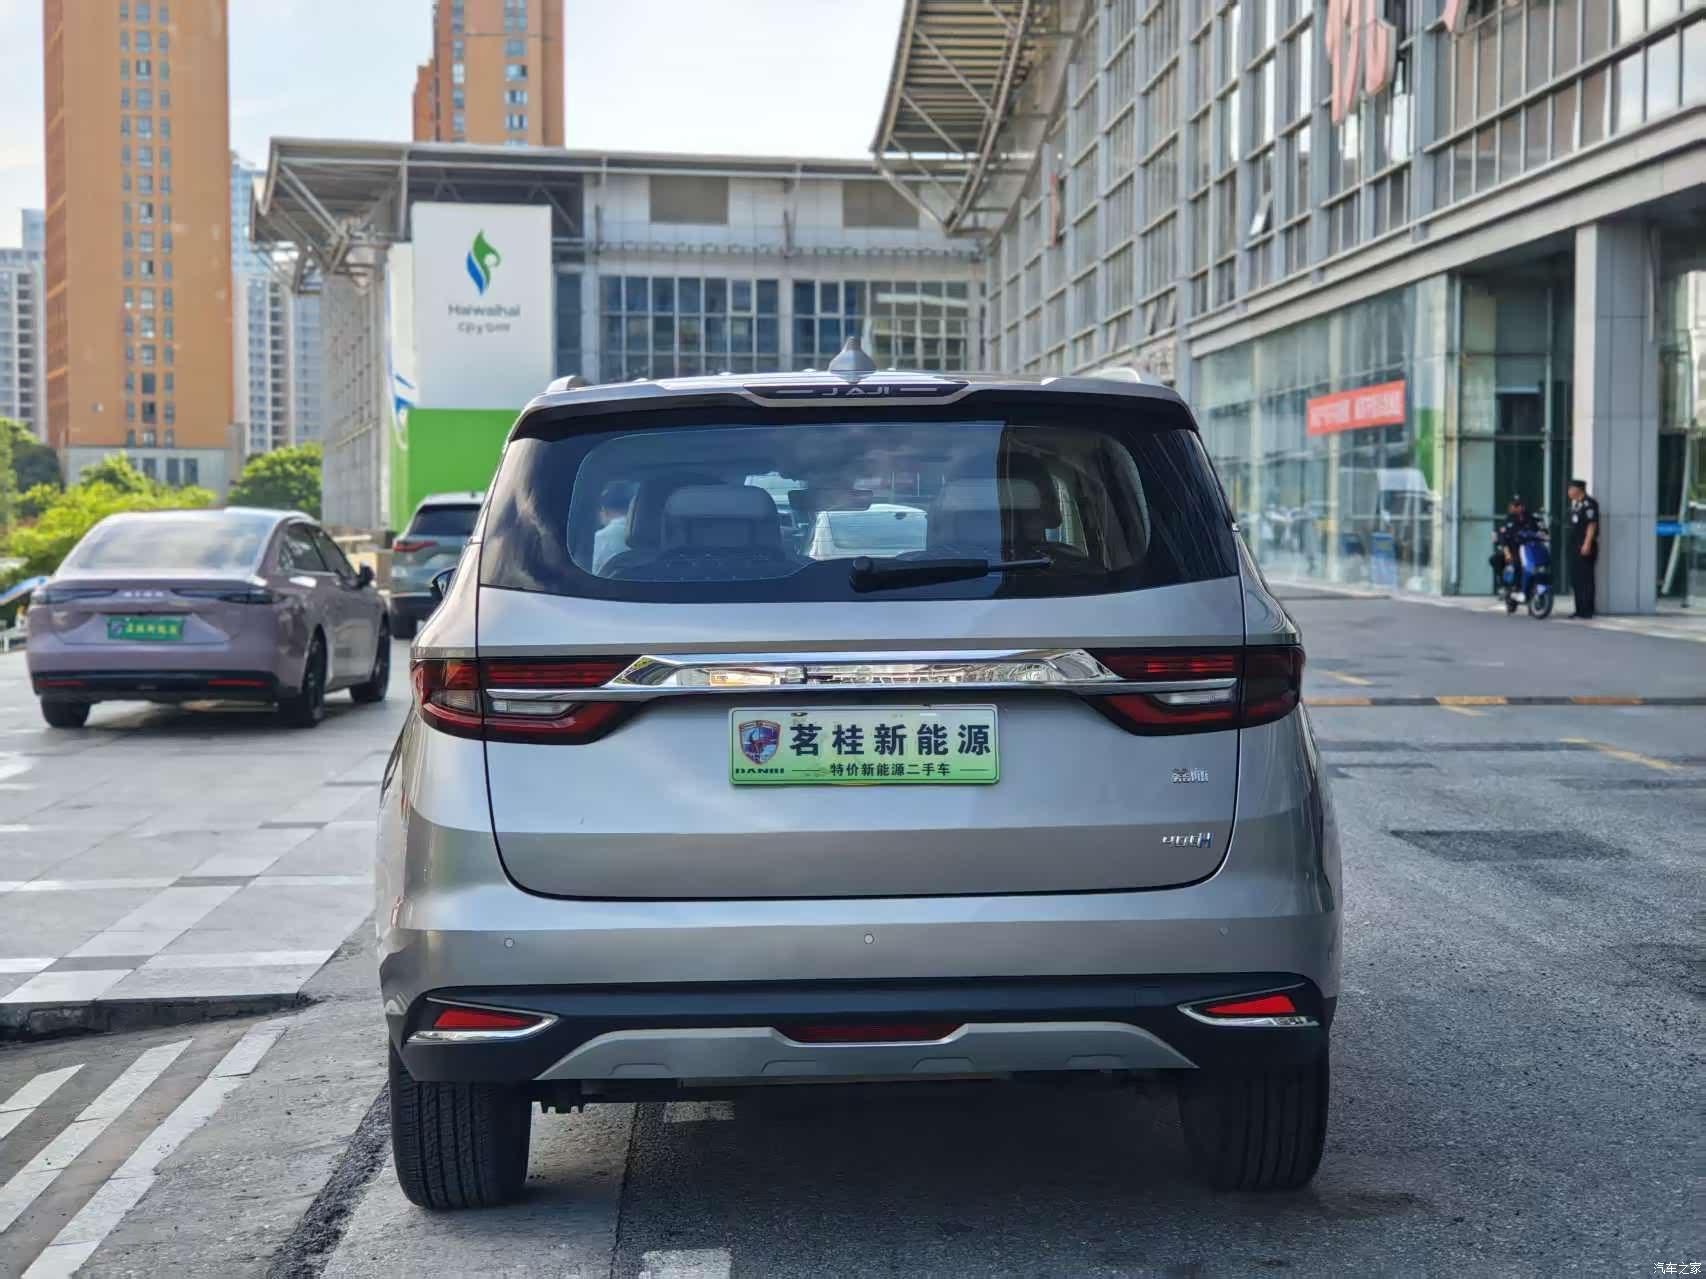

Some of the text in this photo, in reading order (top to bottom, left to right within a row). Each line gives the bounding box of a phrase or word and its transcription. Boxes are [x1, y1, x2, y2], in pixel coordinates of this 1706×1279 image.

[789, 723, 991, 757] 茗桂新能源
[829, 763, 951, 777] 特价新能源二手车
